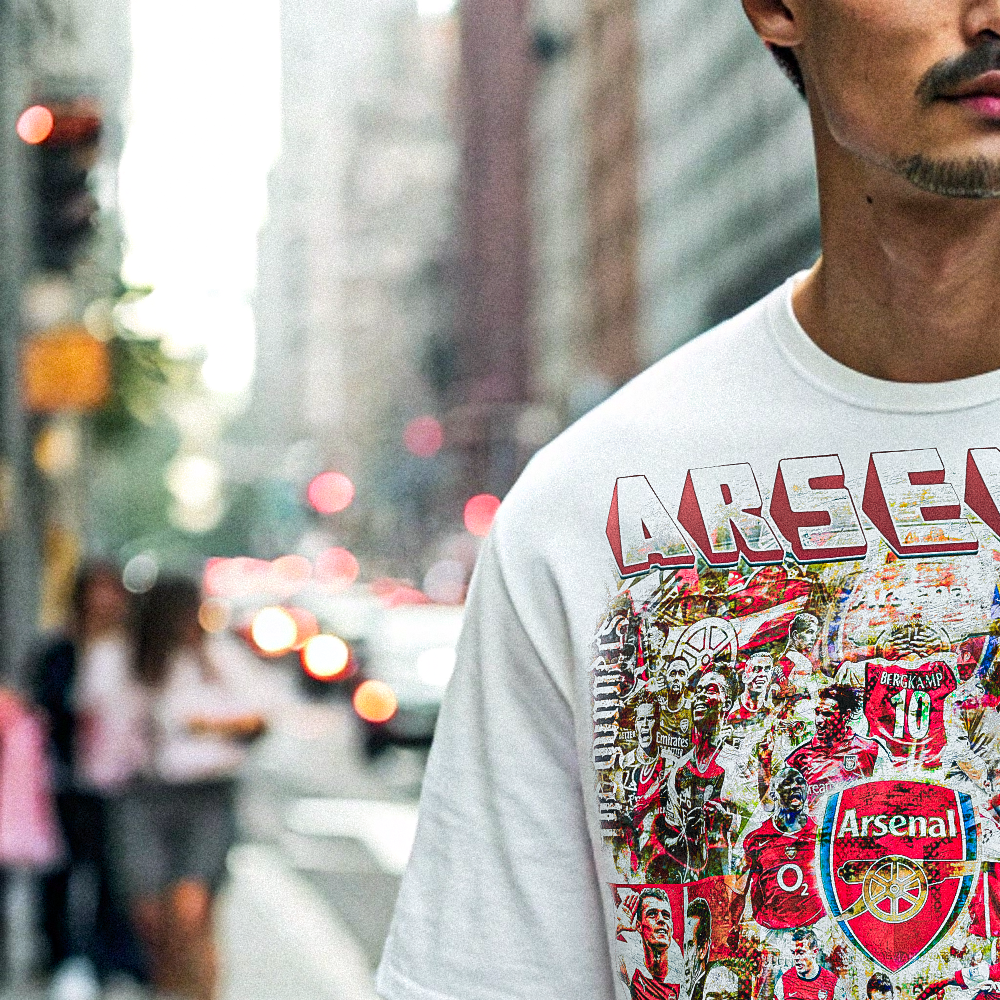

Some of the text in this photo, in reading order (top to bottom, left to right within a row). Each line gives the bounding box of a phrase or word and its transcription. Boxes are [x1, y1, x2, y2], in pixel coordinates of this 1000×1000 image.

[880, 671, 943, 690] BERGKAMP
[891, 688, 931, 740] 10
[656, 731, 690, 748] Emirates
[837, 808, 957, 838] Arsenal
